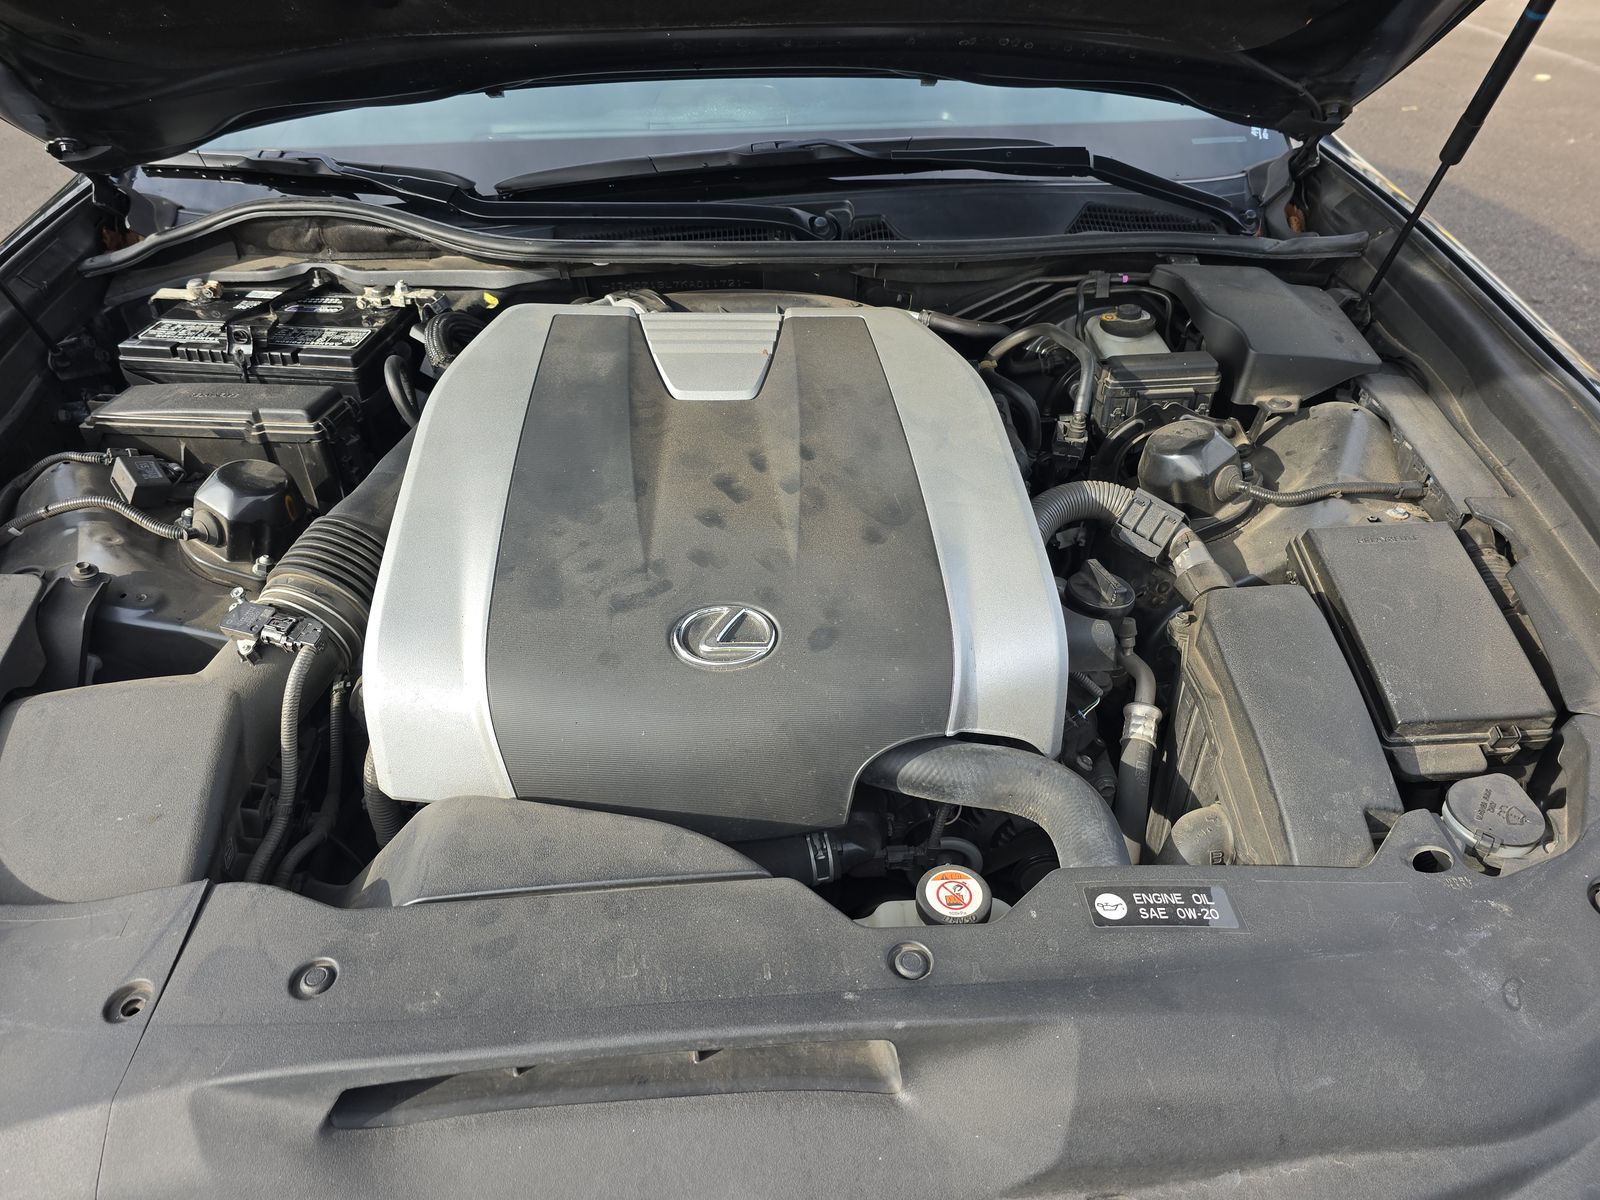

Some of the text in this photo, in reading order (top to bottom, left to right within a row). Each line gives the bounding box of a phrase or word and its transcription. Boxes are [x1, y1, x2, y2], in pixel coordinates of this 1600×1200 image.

[1133, 893, 1215, 905] ENGINE OIL
[1140, 907, 1220, 920] SAE 0W-20
